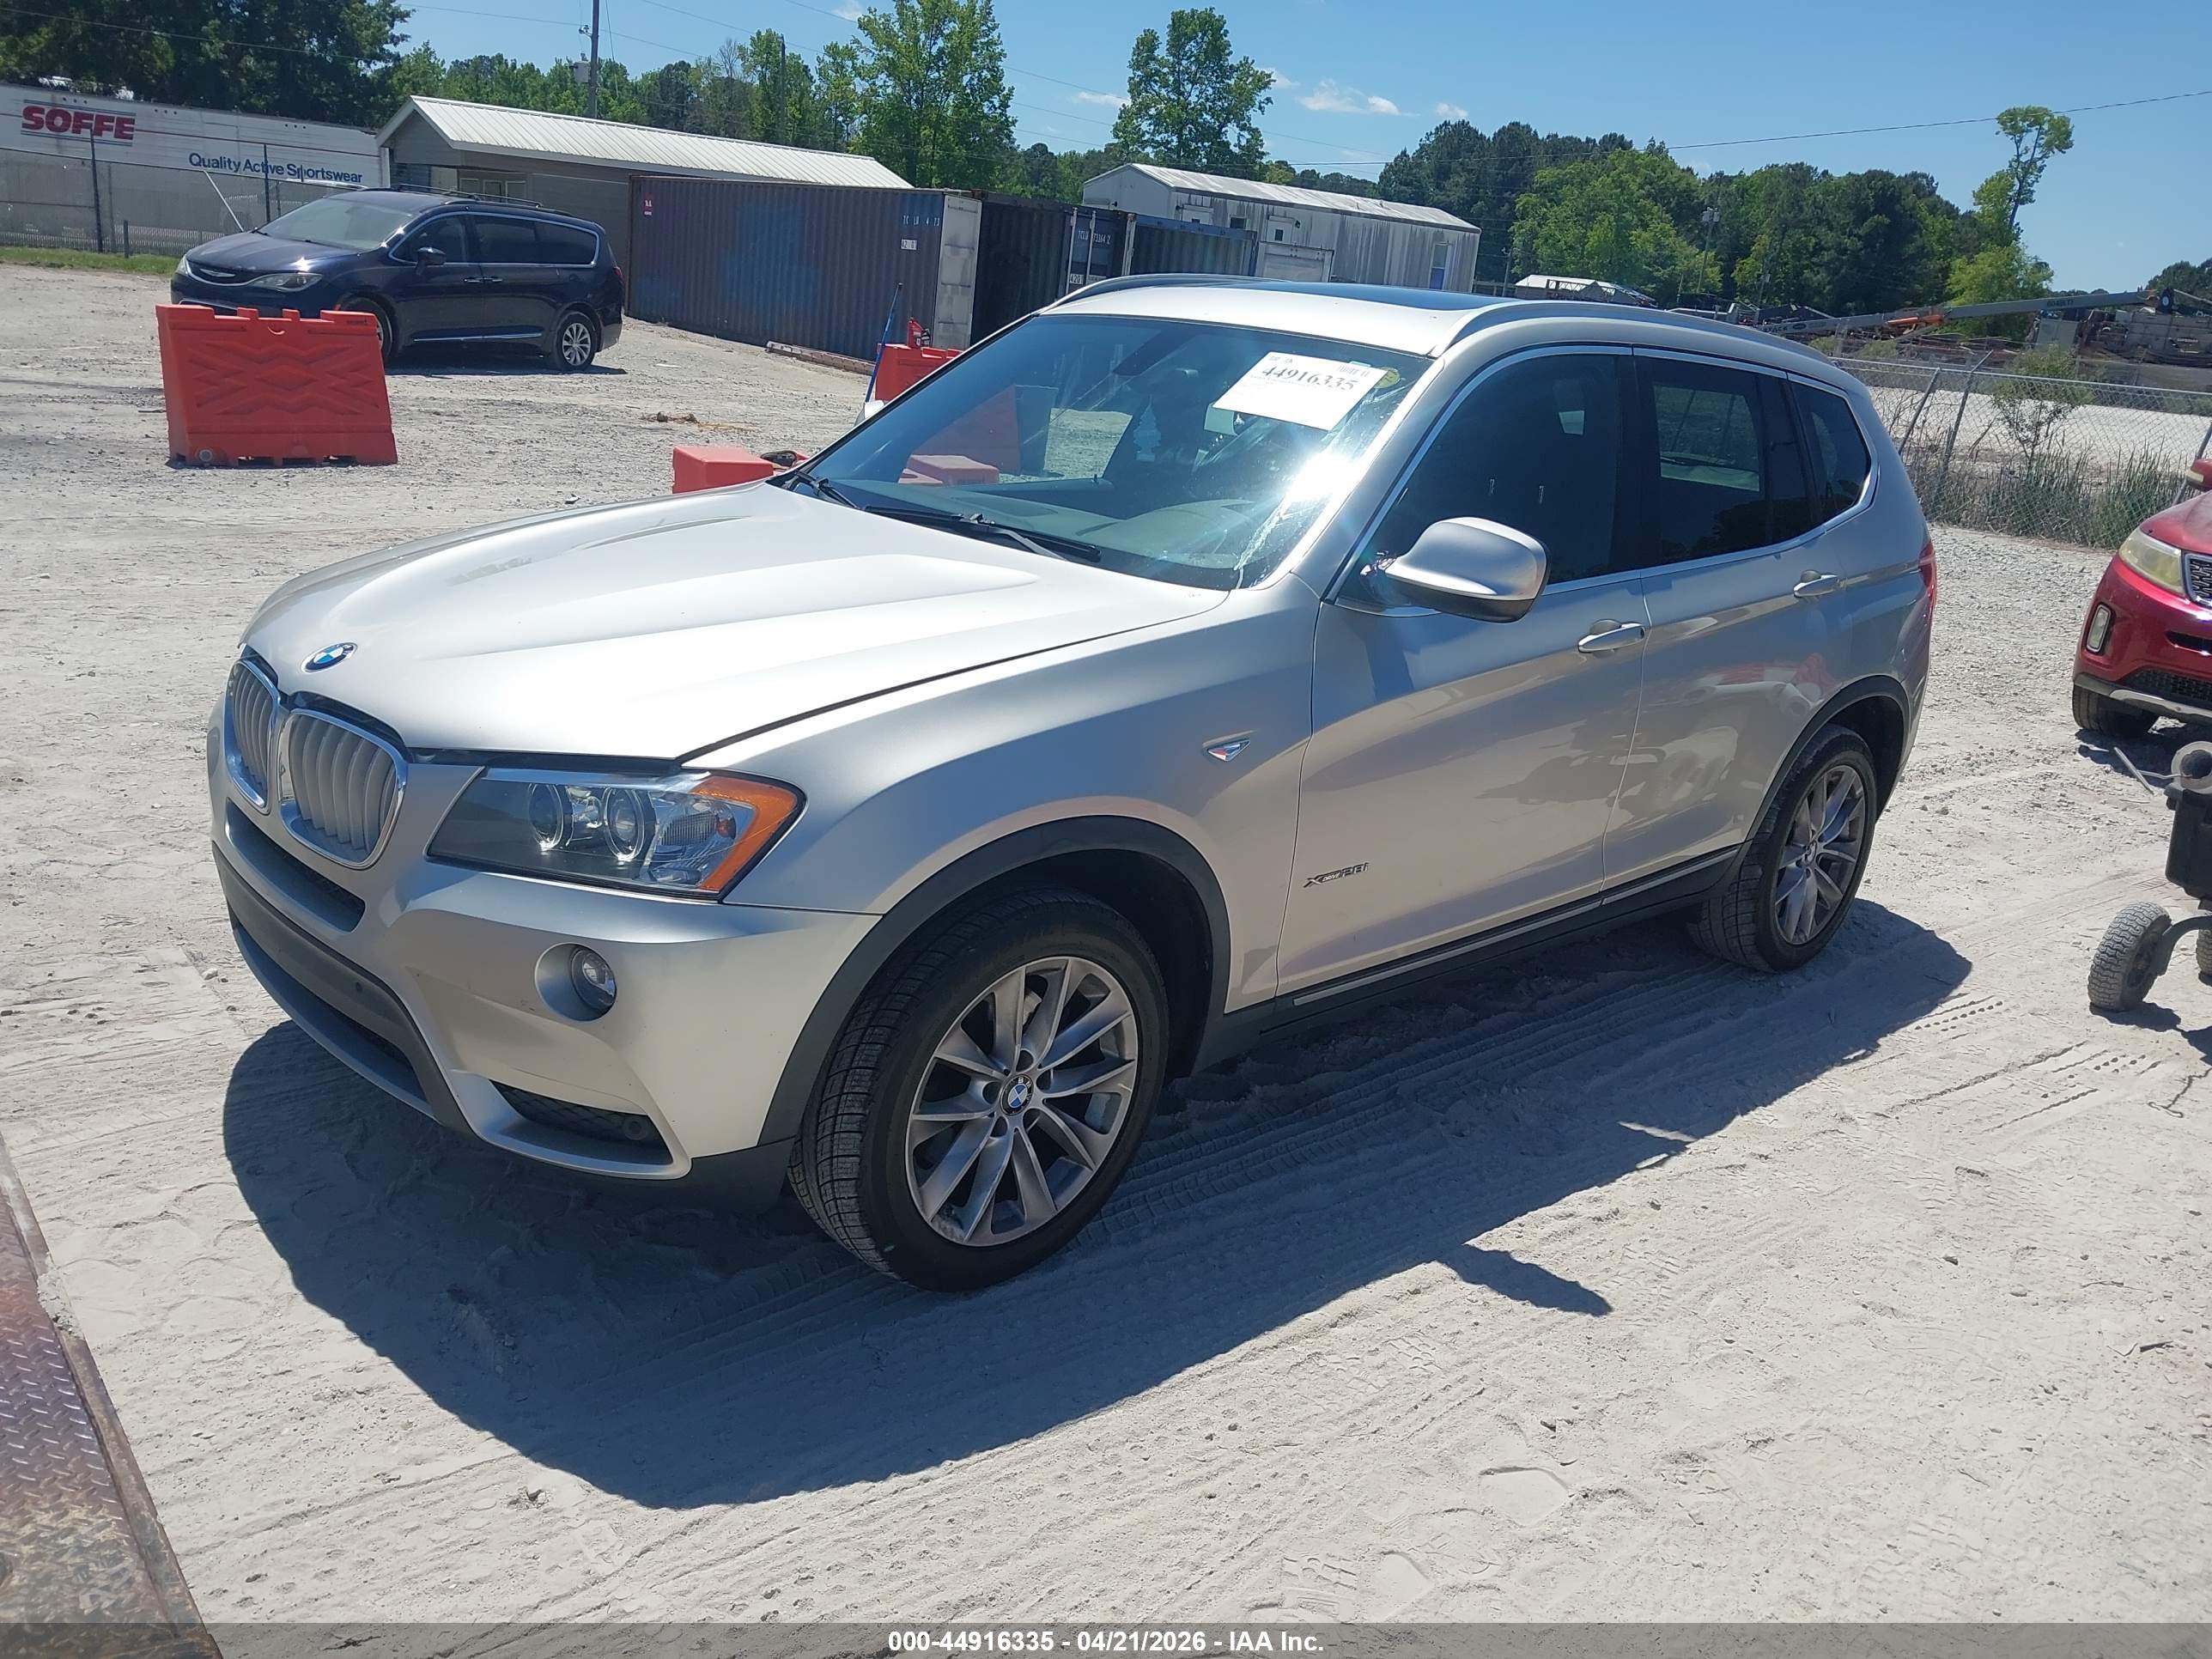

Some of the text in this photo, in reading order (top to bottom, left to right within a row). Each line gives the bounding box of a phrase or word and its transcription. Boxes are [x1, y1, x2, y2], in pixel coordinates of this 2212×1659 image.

[21, 106, 136, 140] SOFFE
[189, 153, 362, 183] Quality Active Sportswear
[1262, 366, 1358, 391] 44916335
